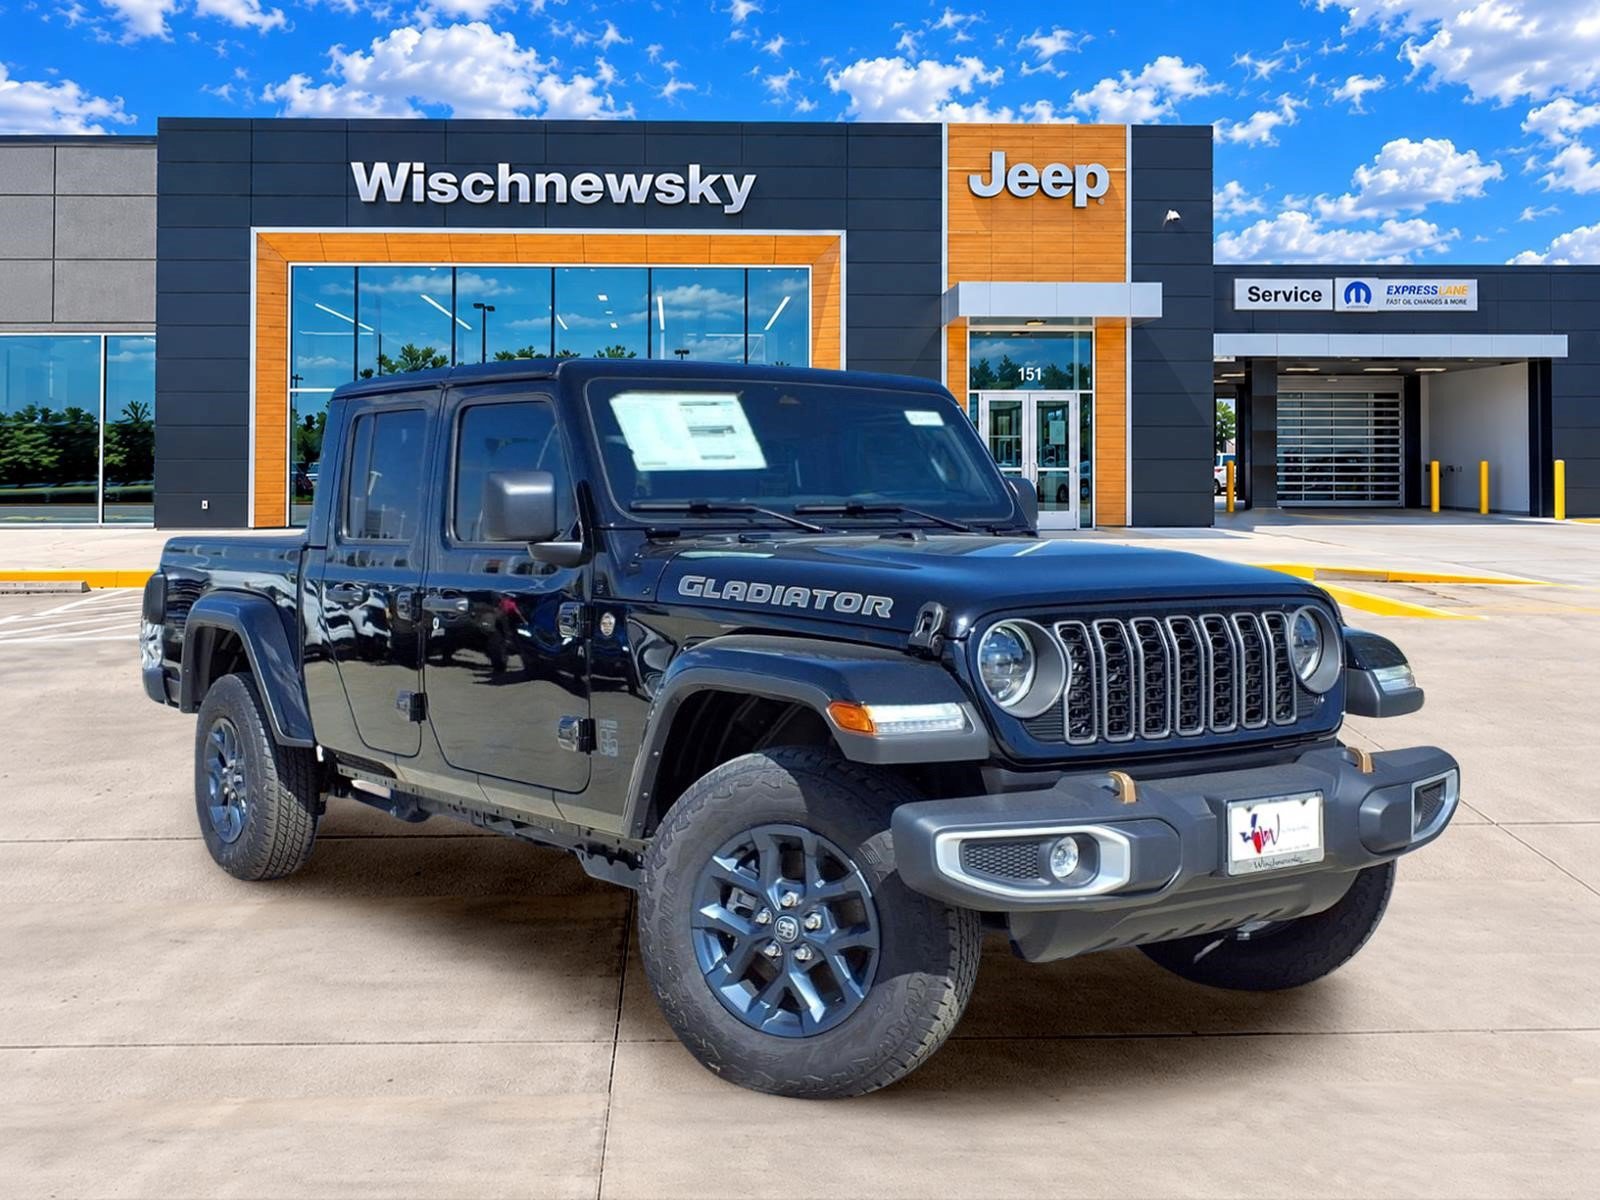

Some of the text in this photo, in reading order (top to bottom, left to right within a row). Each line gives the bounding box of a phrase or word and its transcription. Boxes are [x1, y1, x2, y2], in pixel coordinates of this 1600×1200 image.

[350, 161, 757, 215] Wischnewsky
[968, 150, 1110, 208] Jeep
[1247, 285, 1323, 303] Service
[1018, 367, 1041, 381] 151
[677, 574, 894, 619] GLADIATOR
